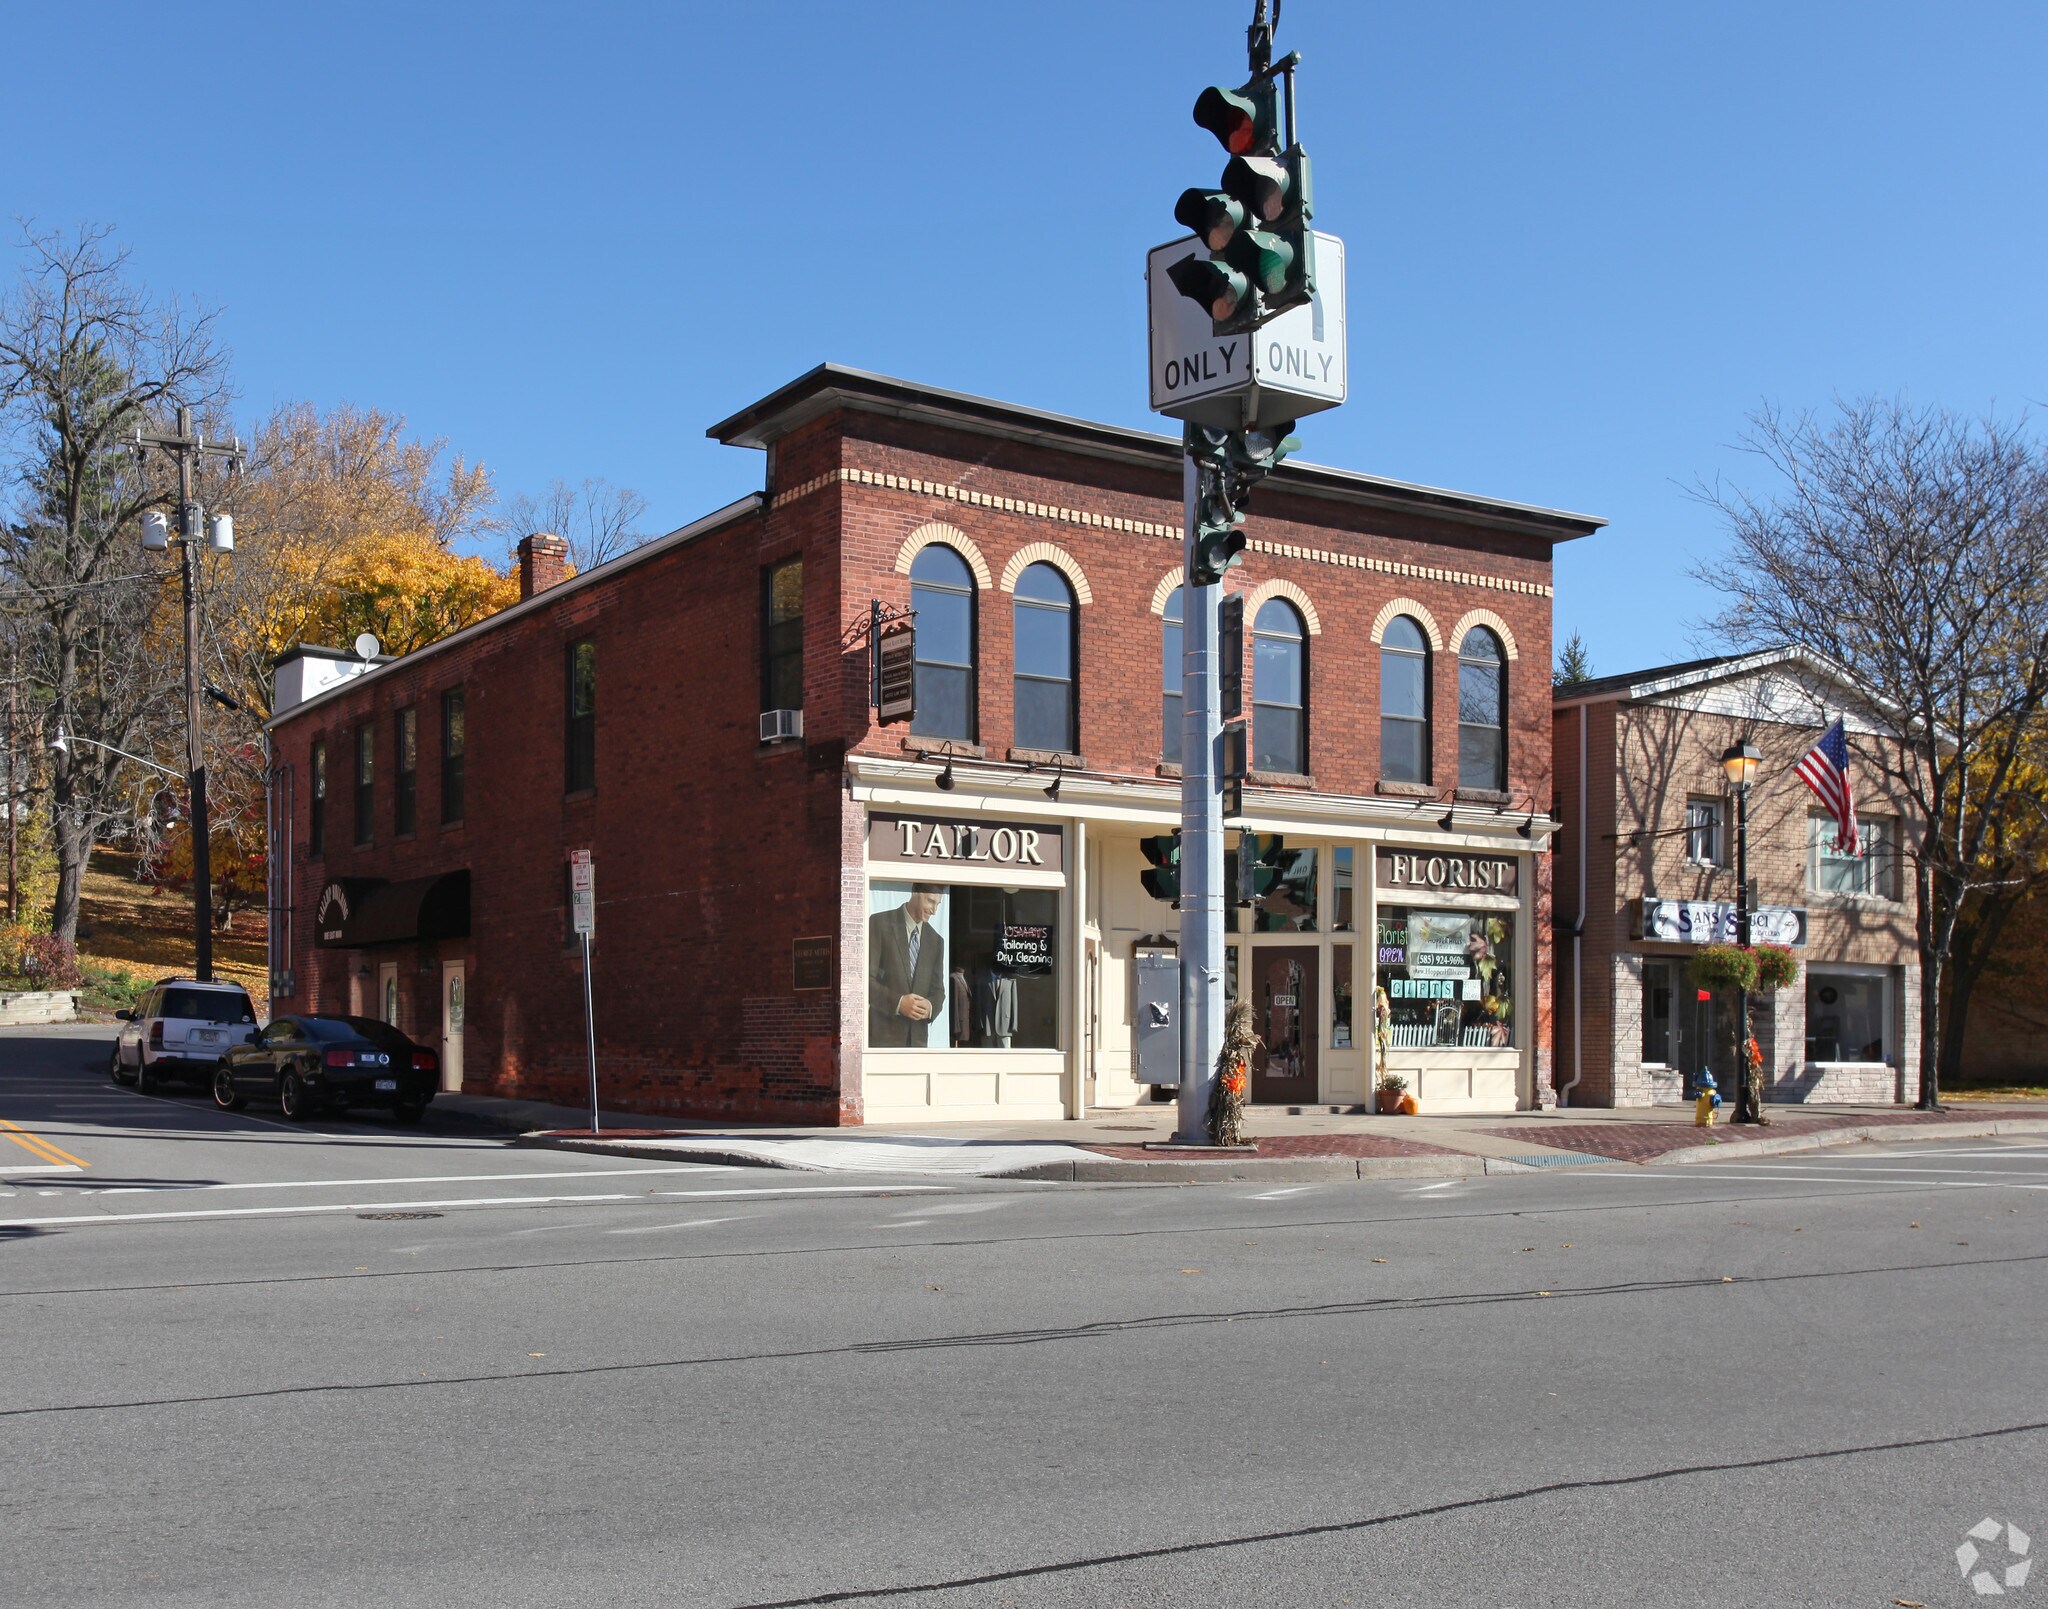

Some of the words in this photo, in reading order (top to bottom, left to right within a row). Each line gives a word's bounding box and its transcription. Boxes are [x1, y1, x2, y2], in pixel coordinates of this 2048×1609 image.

[1165, 342, 1238, 391] ONLY
[1268, 341, 1333, 383] ONLY
[895, 820, 1044, 866] TAILOR
[1390, 853, 1509, 889] FLORIST
[1678, 909, 1719, 934] SANS
[1725, 911, 1769, 936] SUCI
[1002, 938, 1038, 953] Tailoring
[1040, 940, 1047, 951] &
[997, 951, 1013, 965] Dry
[1016, 951, 1053, 966] Cleaning
[1417, 954, 1434, 965] (585)
[1436, 955, 1465, 965] 924-9696
[1393, 981, 1451, 995] GIFTS
[1275, 996, 1295, 1005] OPEN
